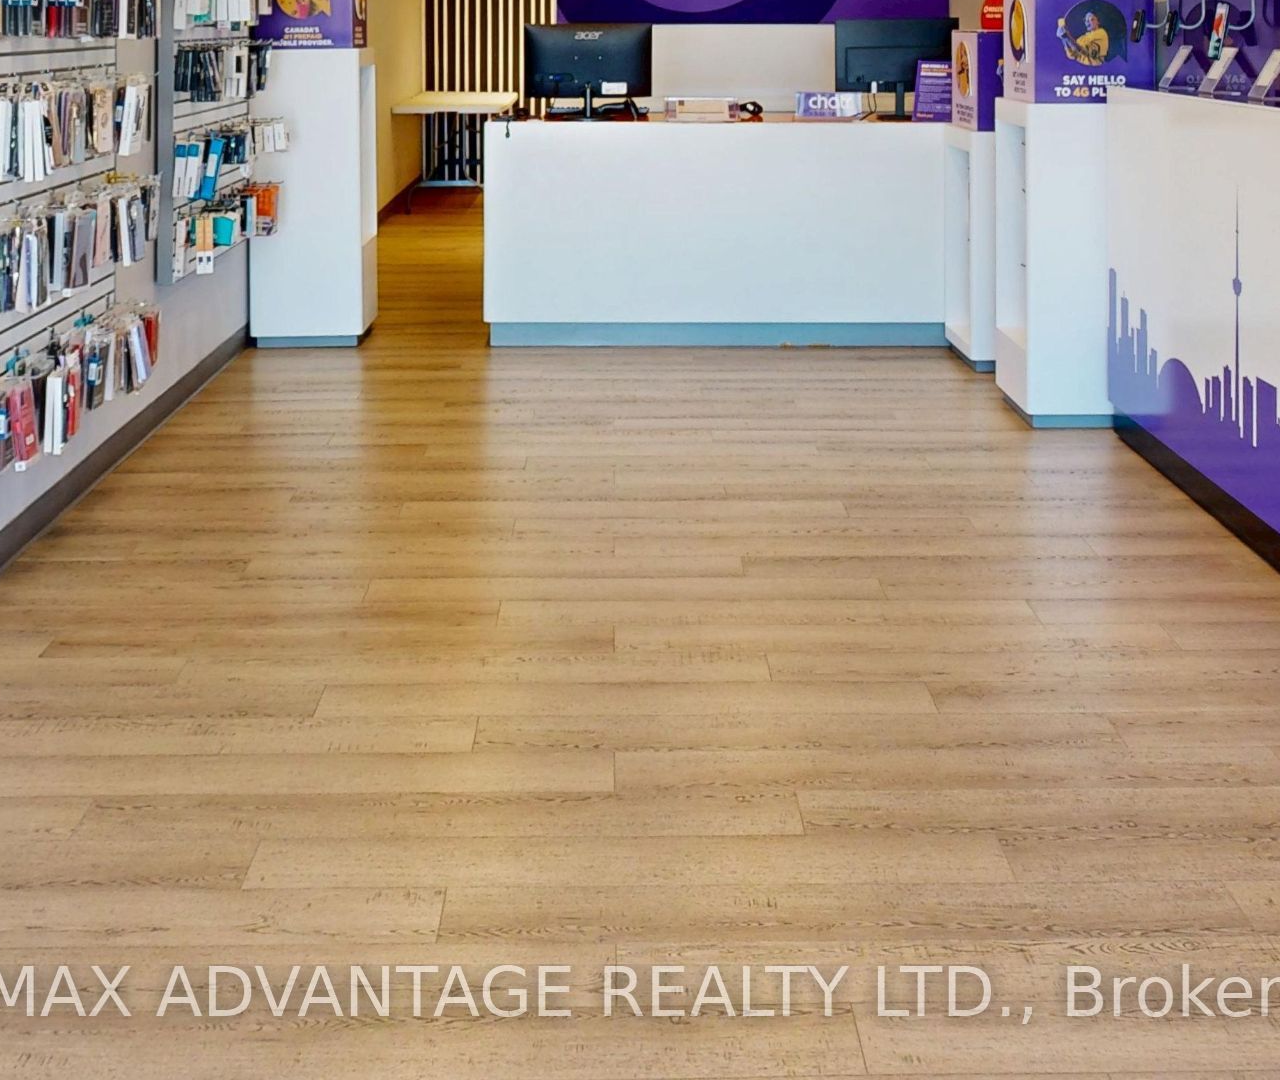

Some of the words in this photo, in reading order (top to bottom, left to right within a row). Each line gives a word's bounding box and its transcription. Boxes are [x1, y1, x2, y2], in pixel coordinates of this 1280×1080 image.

[574, 31, 604, 40] acer
[1063, 75, 1086, 85] SAY
[1088, 75, 1126, 86] HELLO
[1055, 86, 1070, 97] TO
[1072, 86, 1089, 97] 4G
